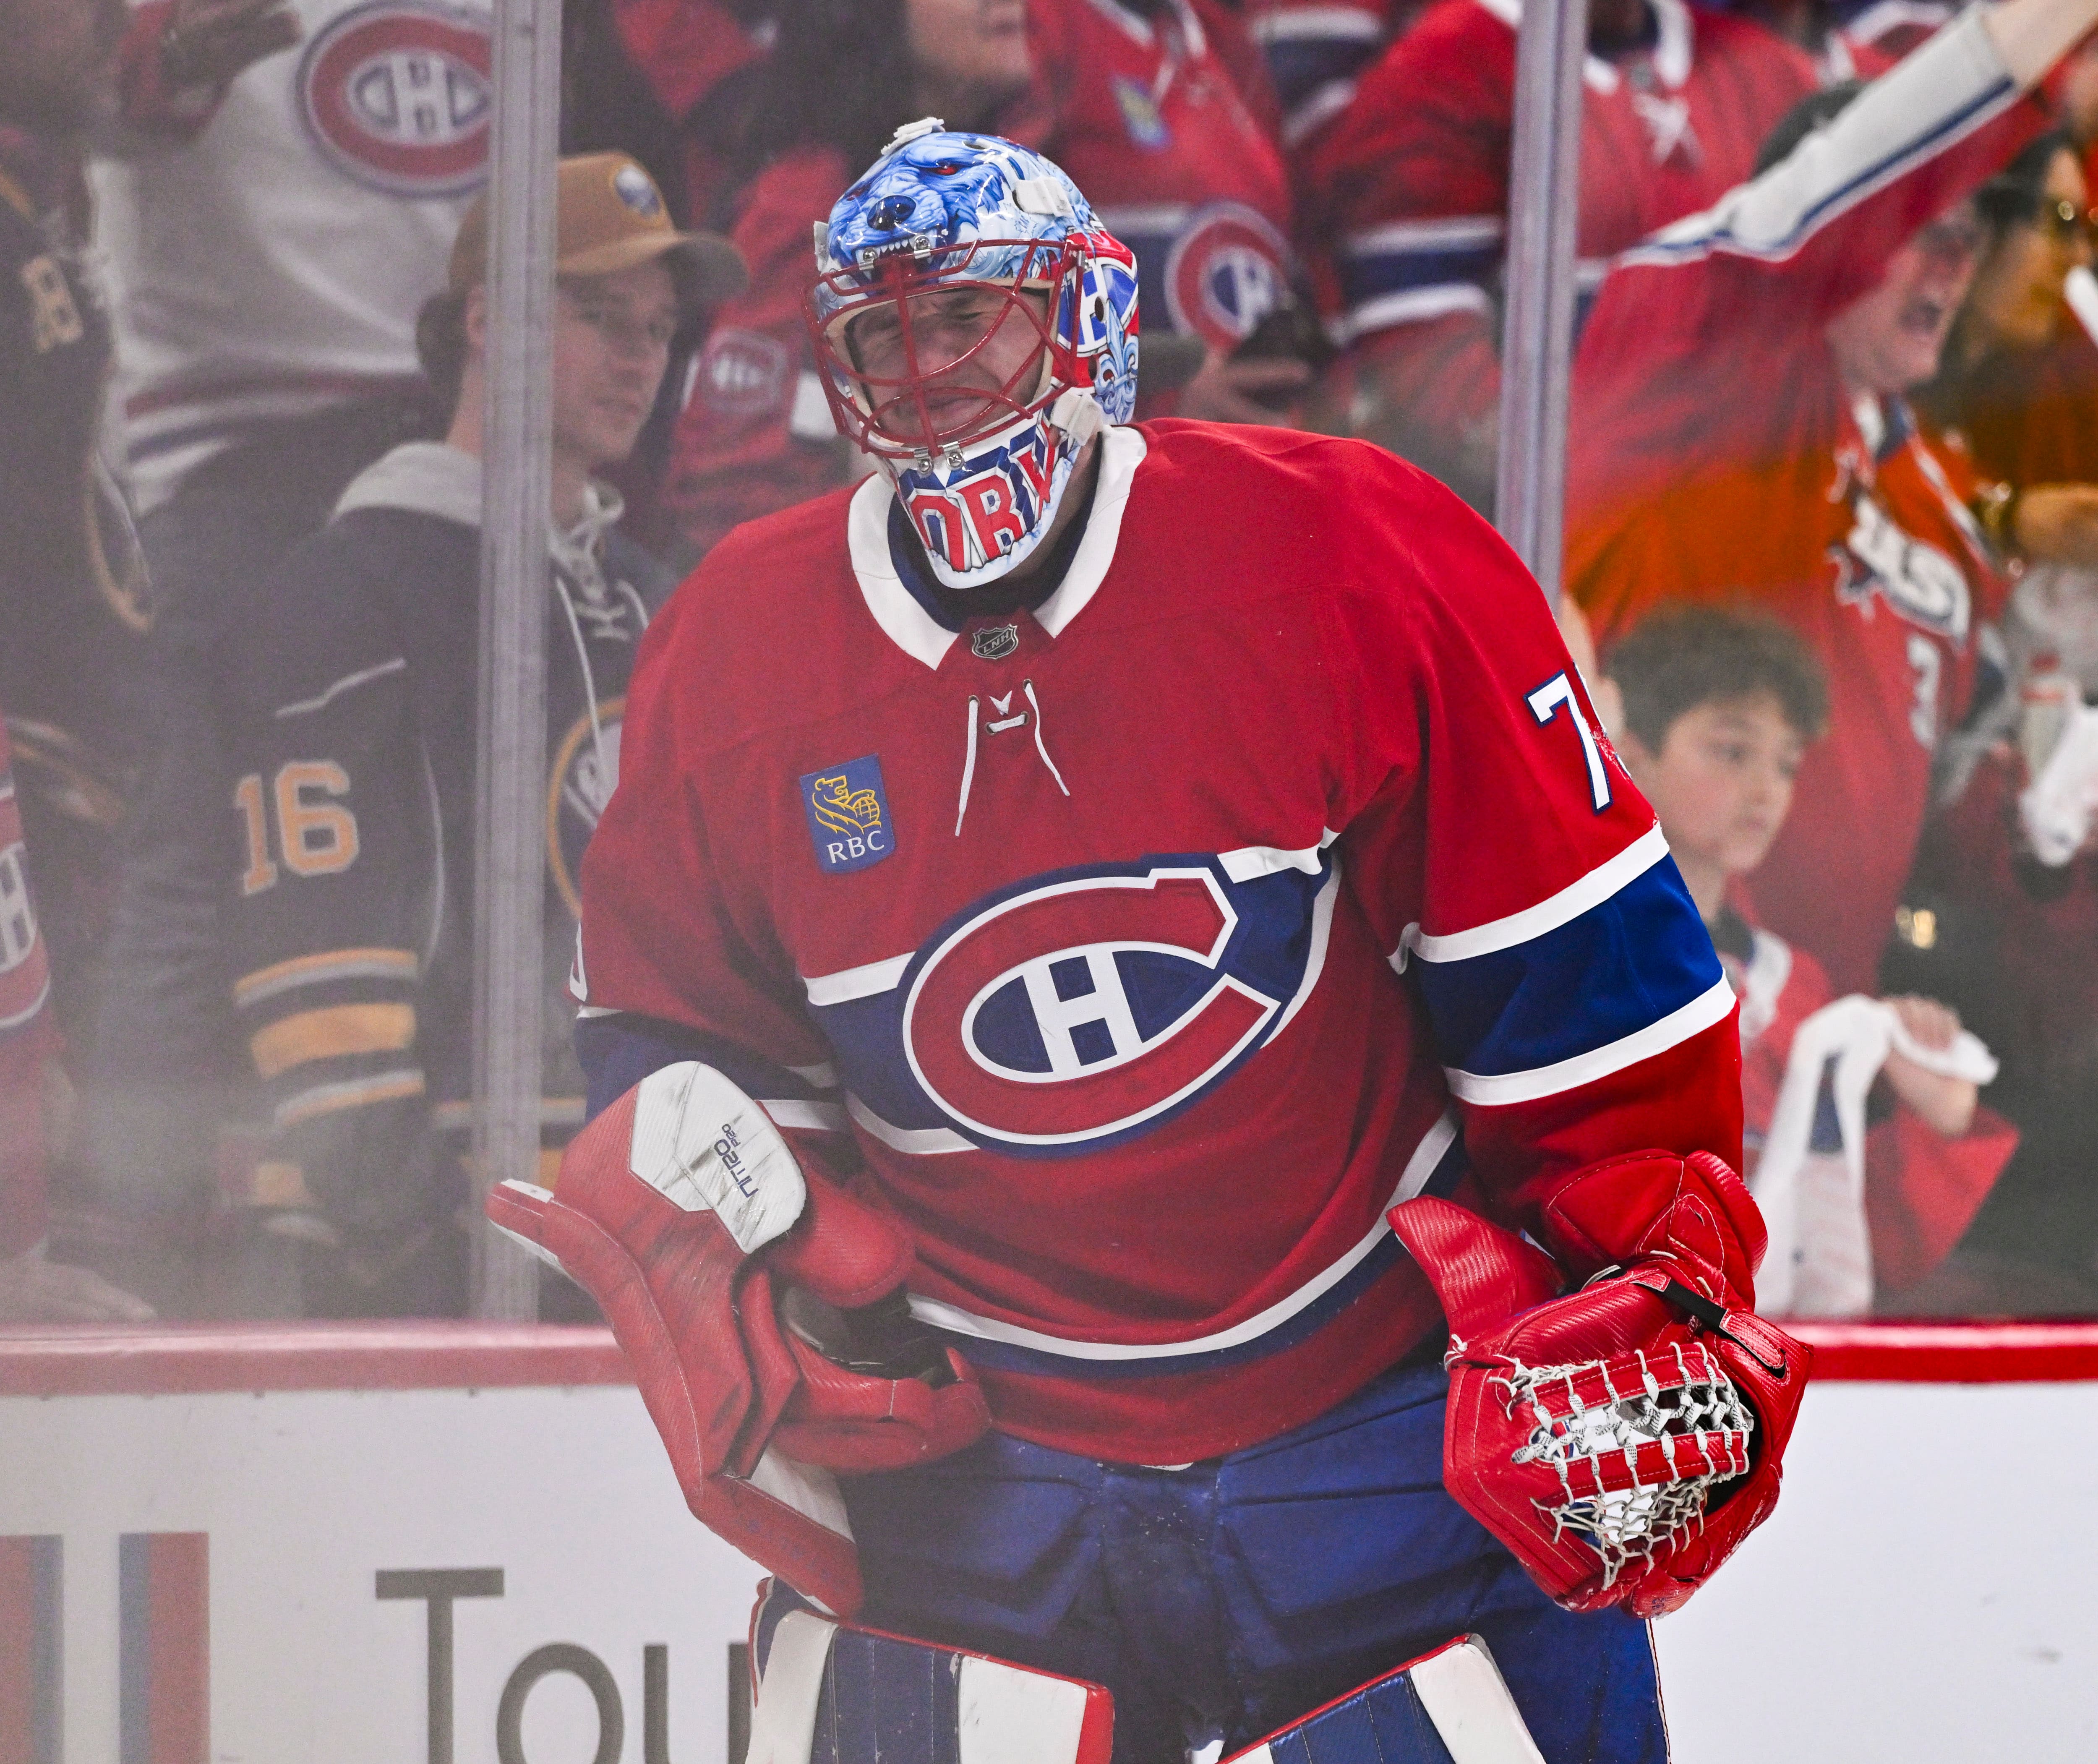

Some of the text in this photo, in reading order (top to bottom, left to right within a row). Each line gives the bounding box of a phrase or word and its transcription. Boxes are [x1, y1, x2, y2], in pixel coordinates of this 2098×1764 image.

[984, 631, 1009, 653] LNH
[1523, 660, 1632, 816] 7
[235, 761, 360, 897] 16
[826, 830, 884, 863] RBC
[721, 1123, 741, 1147] PRO
[714, 1139, 759, 1198] NITRO
